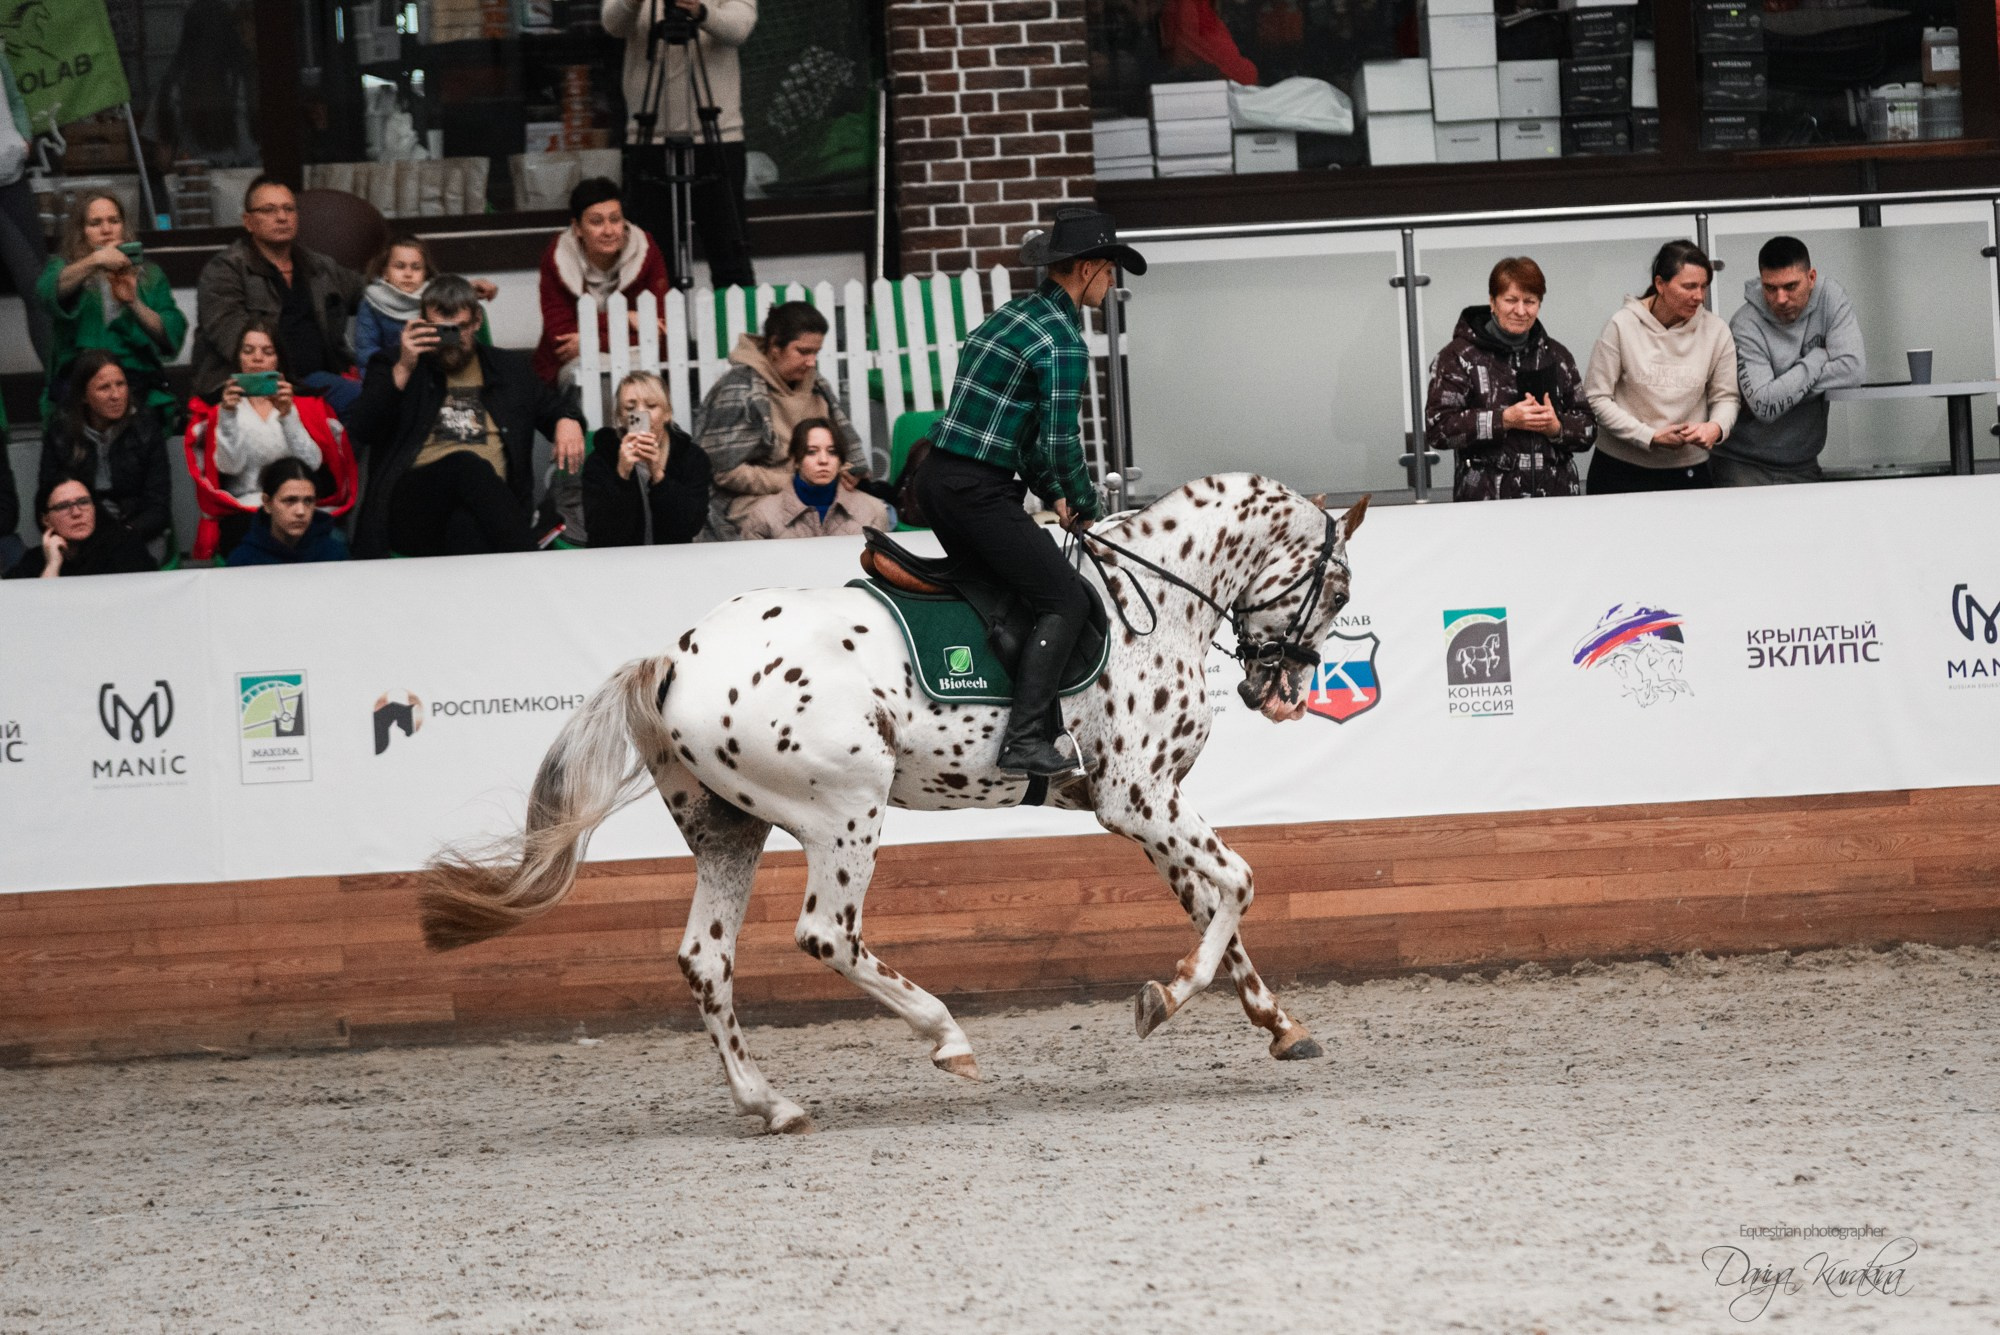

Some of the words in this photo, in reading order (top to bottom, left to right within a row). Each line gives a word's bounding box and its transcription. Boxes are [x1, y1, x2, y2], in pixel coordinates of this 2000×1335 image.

[18, 53, 93, 94] OLAB
[1747, 620, 1877, 645] КРЫЛАТЫЙ
[1747, 641, 1880, 669] ЭКЛИПС
[939, 677, 988, 690] Biotech
[1448, 684, 1513, 699] КОННАЯ
[1449, 699, 1514, 714] РОССИЯ
